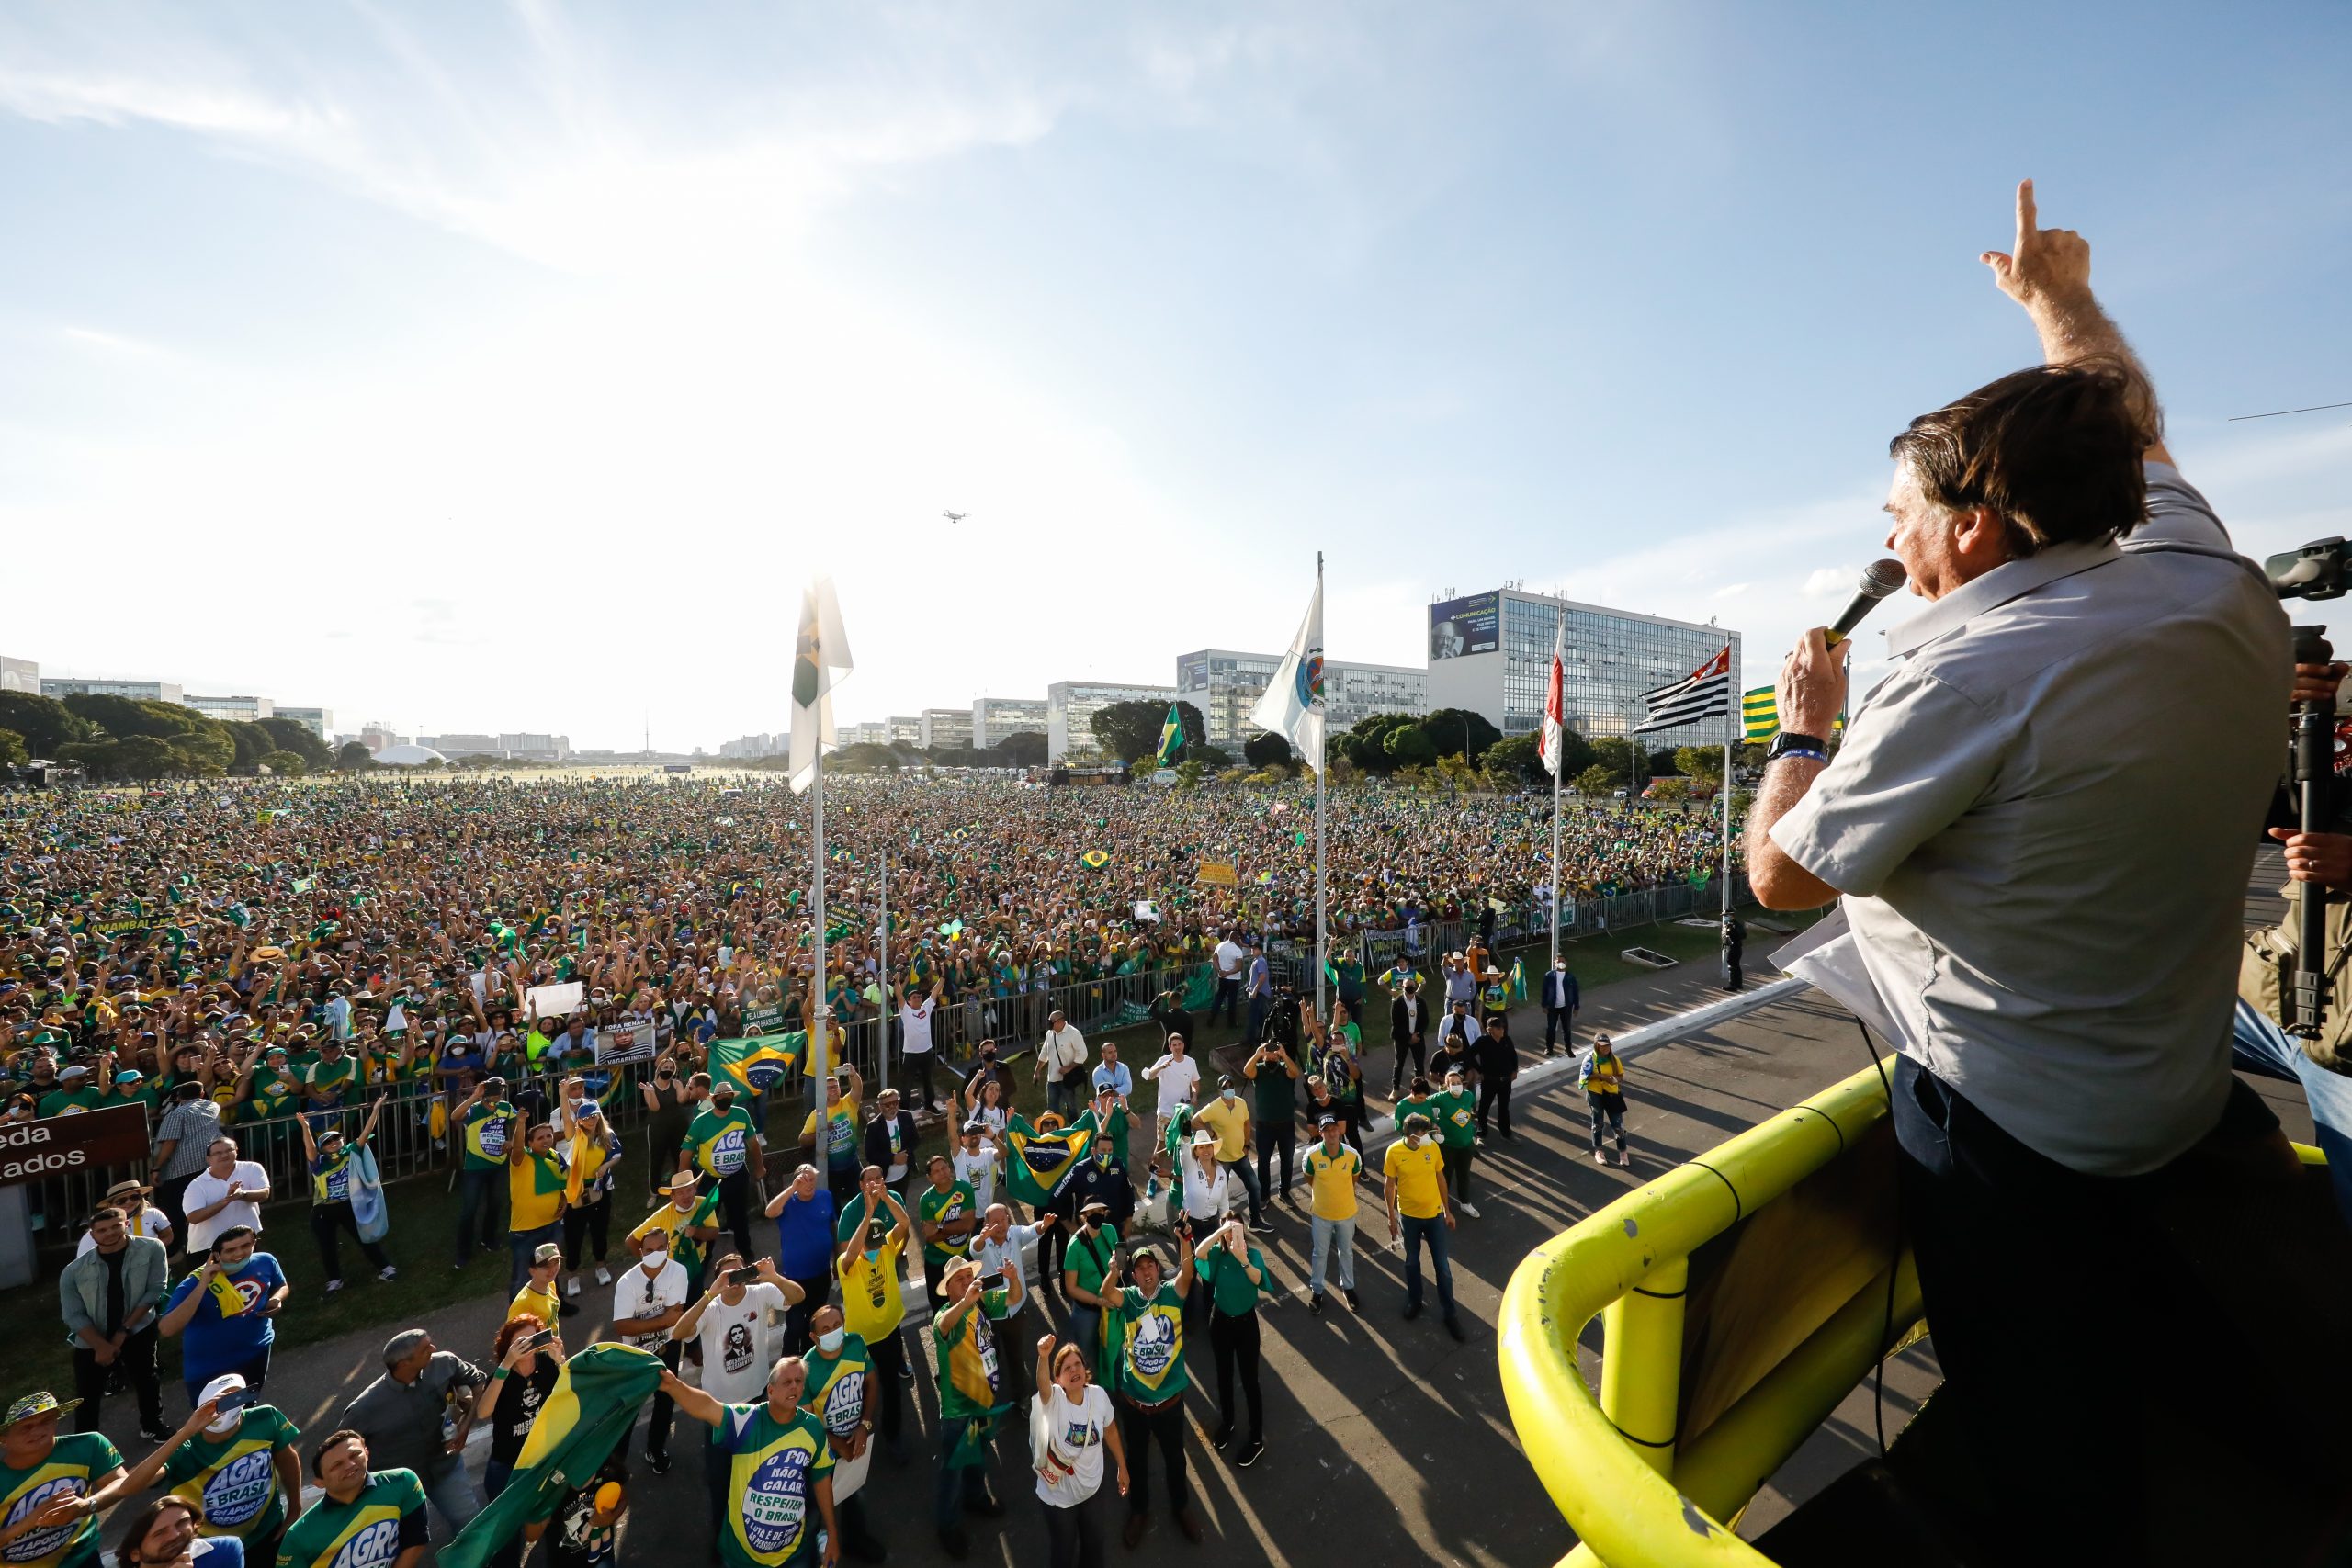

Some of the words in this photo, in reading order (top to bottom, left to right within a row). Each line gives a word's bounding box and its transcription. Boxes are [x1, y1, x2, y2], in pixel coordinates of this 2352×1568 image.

[91, 920, 149, 932] AMAMBAI
[746, 1011, 757, 1021] PELA
[757, 1007, 778, 1019] LIBERDADE
[761, 1016, 783, 1028] BRASILEIRO
[623, 1020, 646, 1028] RENAN
[607, 1054, 647, 1065] VAGABUNDO
[714, 1130, 745, 1153] AGR
[0, 1149, 85, 1179] ados
[722, 1151, 745, 1165] BRAS
[943, 1205, 961, 1224] AGR
[835, 1404, 861, 1424] BRAS
[513, 1417, 536, 1430] BOLSO
[766, 1455, 779, 1466] O
[784, 1450, 812, 1467] POV
[771, 1466, 798, 1479] NÃO
[749, 1492, 804, 1512] RESPEITEM
[210, 1507, 260, 1526] PRESIDENT
[754, 1507, 763, 1518] O
[764, 1510, 798, 1523] BRASIL
[750, 1522, 765, 1539] LUTA
[772, 1531, 784, 1540] DE
[24, 1531, 60, 1551] APOIO
